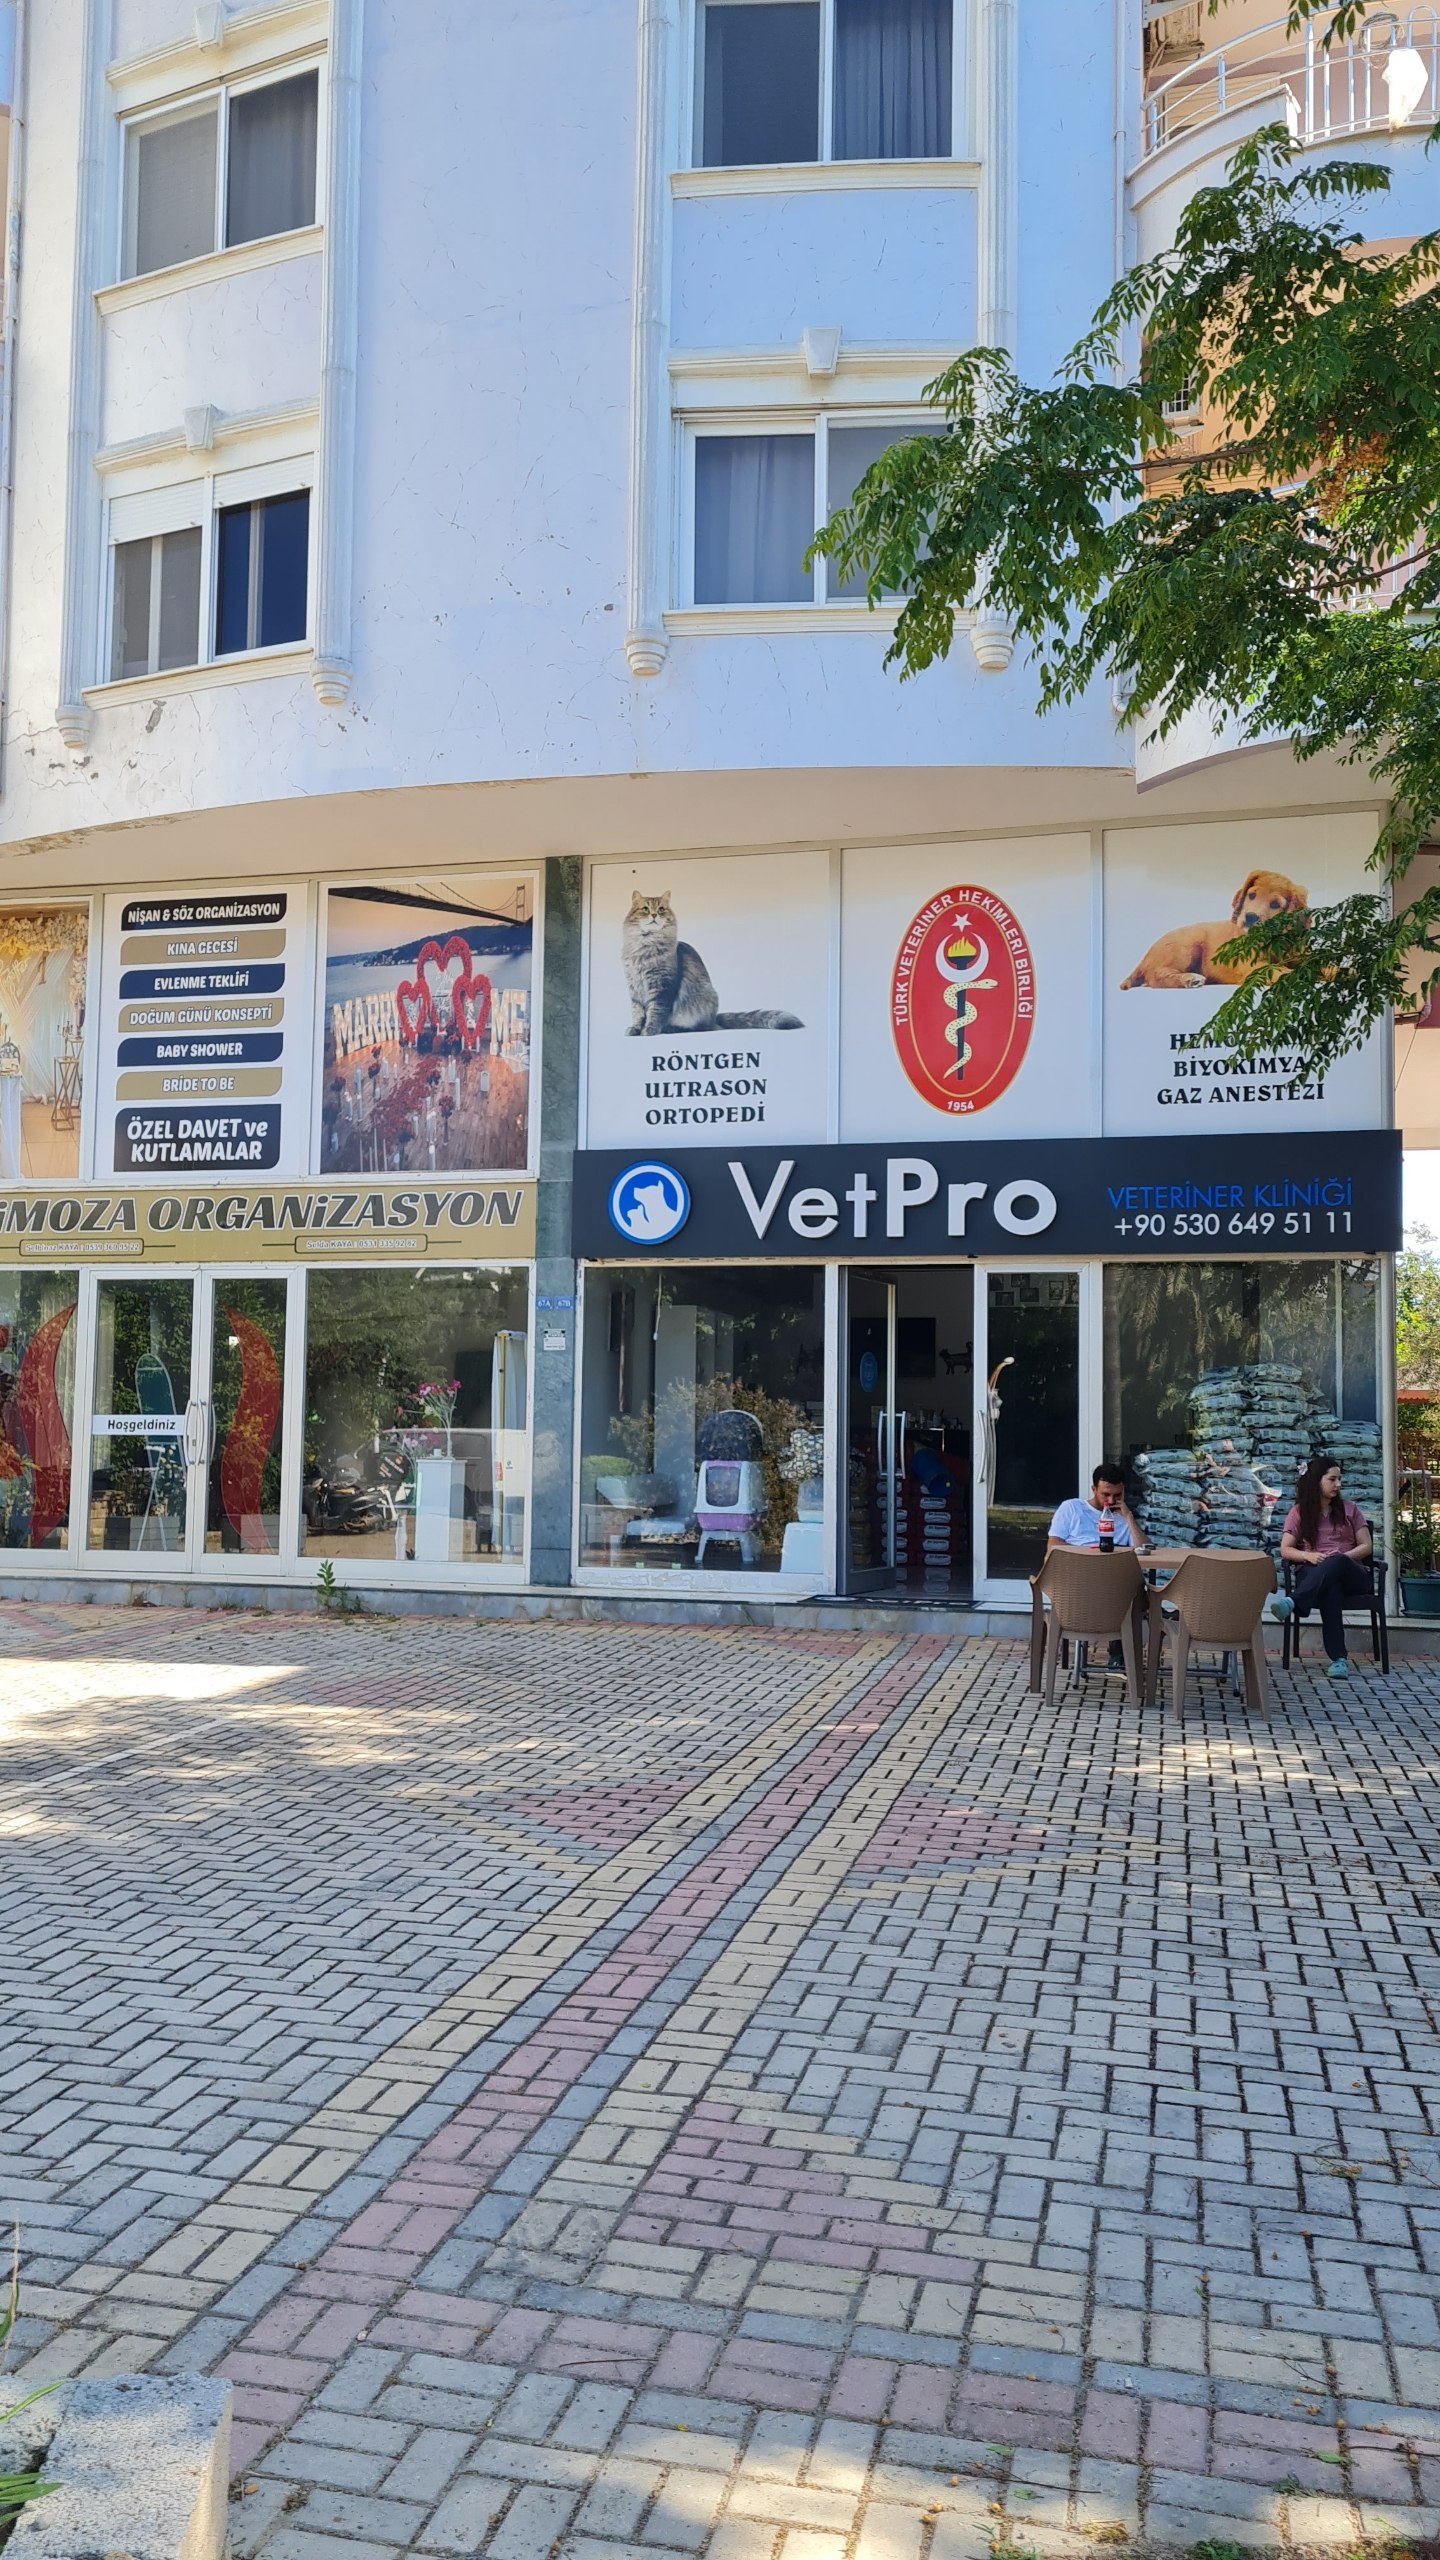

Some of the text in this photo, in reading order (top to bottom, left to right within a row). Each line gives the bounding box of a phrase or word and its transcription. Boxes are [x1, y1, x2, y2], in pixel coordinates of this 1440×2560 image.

[128, 902, 280, 925] NİŞAN & SÖZ ORGANİZASYON
[167, 936, 238, 956] KINA GECESİ
[893, 890, 1034, 1026] TÜRK VETERİNER HEKİMLERİ BİRLİĞİ
[154, 970, 250, 991] EVLENME TEKLİFİ
[130, 1004, 272, 1026] DOĞUM GÜNÜ KONSEPTİ
[156, 1042, 243, 1058] BABY SHOWER
[651, 1050, 761, 1072] RÖNTGEN
[162, 1075, 234, 1092] BRİDE TO BE
[645, 1078, 768, 1098] ULTRASON
[947, 1100, 974, 1112] 1954
[1157, 1088, 1202, 1105] GAZ
[645, 1101, 766, 1125] ORTOPEDİ
[127, 1116, 268, 1140] ÖZEL DAVET ve
[131, 1140, 262, 1162] KUTLAMALAR
[728, 1157, 1058, 1240] VetPro
[1107, 1177, 1352, 1210] VETERİNER KLİNİĞİ
[1114, 1211, 1352, 1236] +90 530 649 51 11
[58, 1242, 79, 1252] KAYA
[330, 1240, 353, 1248] KAYA
[108, 1419, 176, 1432] Hoşgeldiniz
